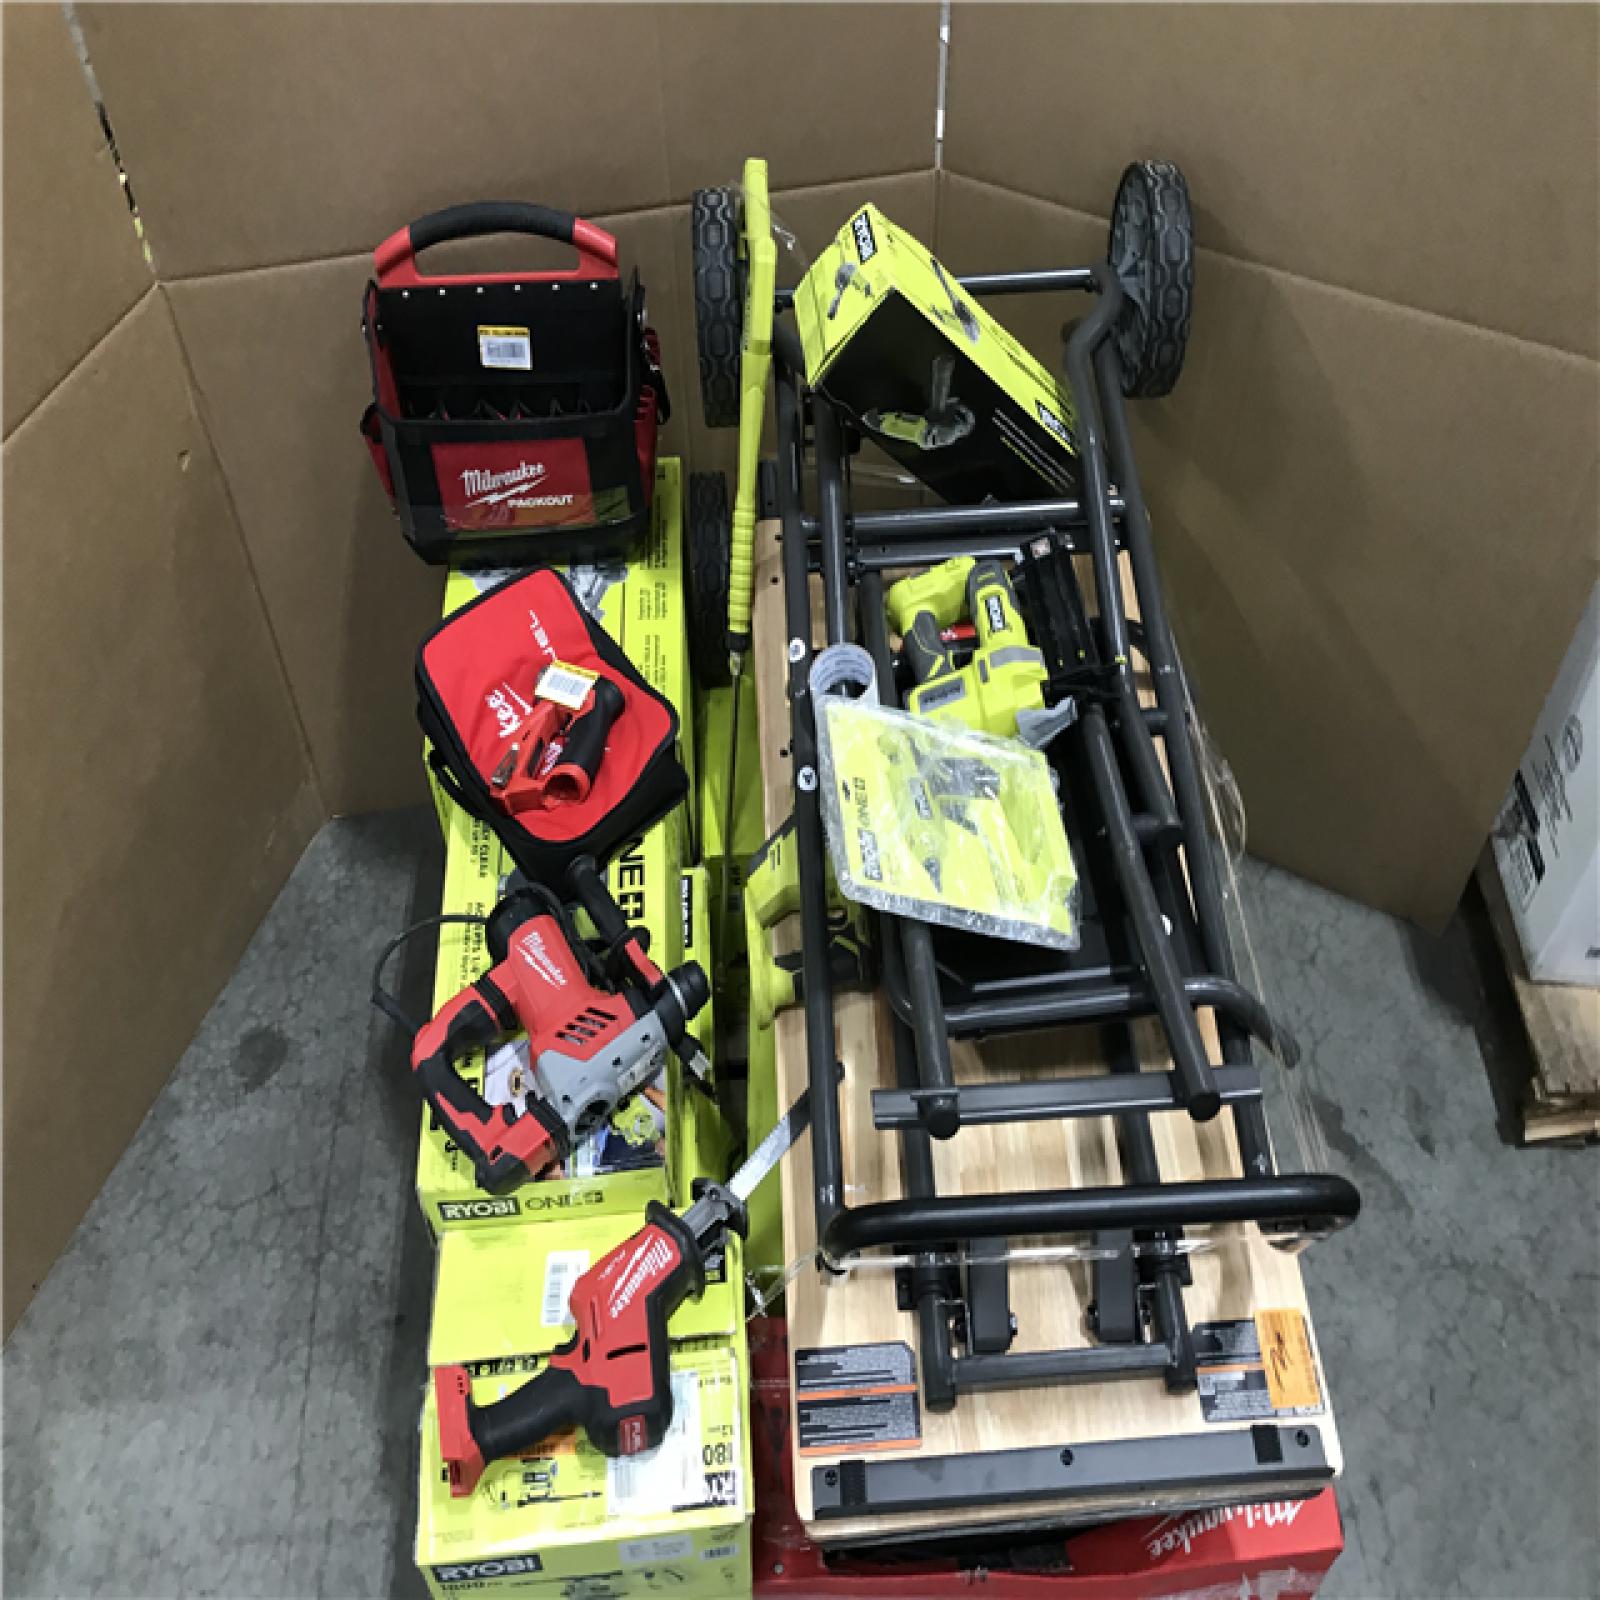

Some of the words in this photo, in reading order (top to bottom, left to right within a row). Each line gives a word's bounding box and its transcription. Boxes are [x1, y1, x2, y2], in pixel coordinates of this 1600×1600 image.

[459, 460, 545, 496] Milwaukee
[507, 495, 574, 508] PACKOUT
[441, 1199, 517, 1219] RYOBI
[434, 1556, 537, 1580] RYOBI
